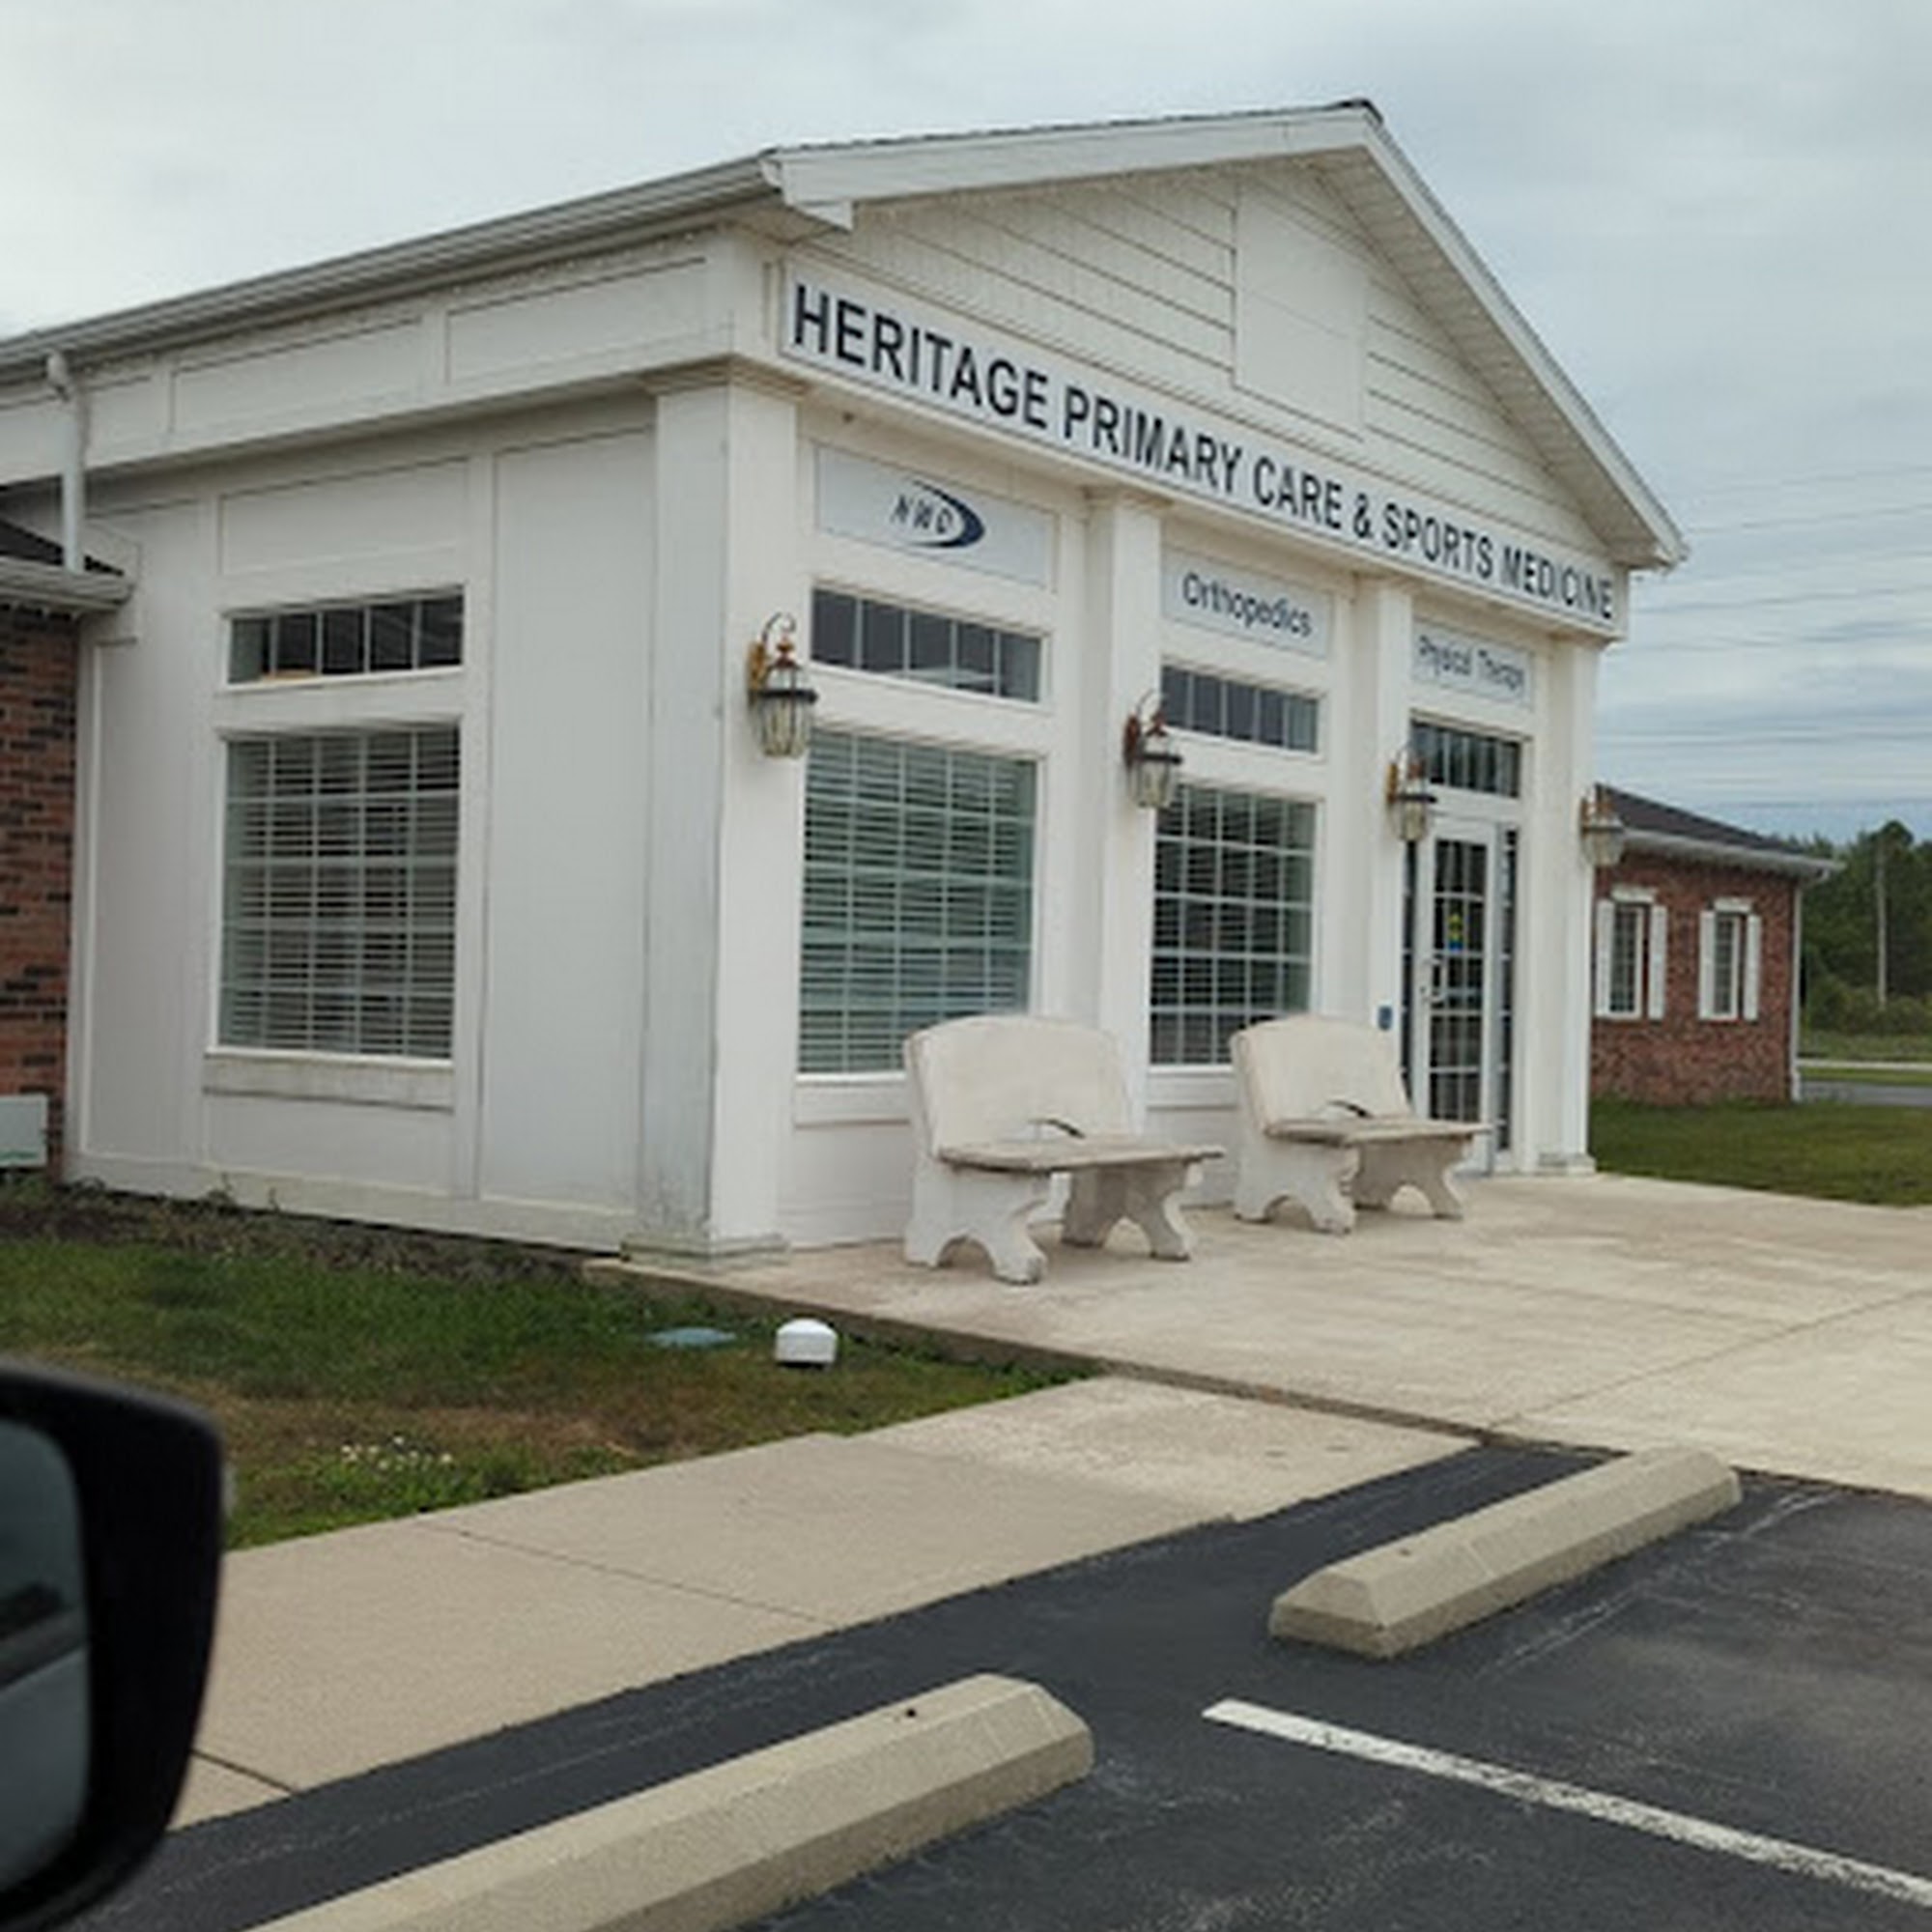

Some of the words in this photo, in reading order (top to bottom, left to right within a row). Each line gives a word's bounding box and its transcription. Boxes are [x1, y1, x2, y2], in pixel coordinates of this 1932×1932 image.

[793, 284, 1048, 429] HERITAGE
[1064, 385, 1242, 493] PRIMARY
[1254, 456, 1342, 530] CARE
[1353, 493, 1374, 539] &
[1382, 502, 1493, 580] SPORTS
[1502, 545, 1612, 620] MEDICINE
[1182, 571, 1313, 638] Orthopedics
